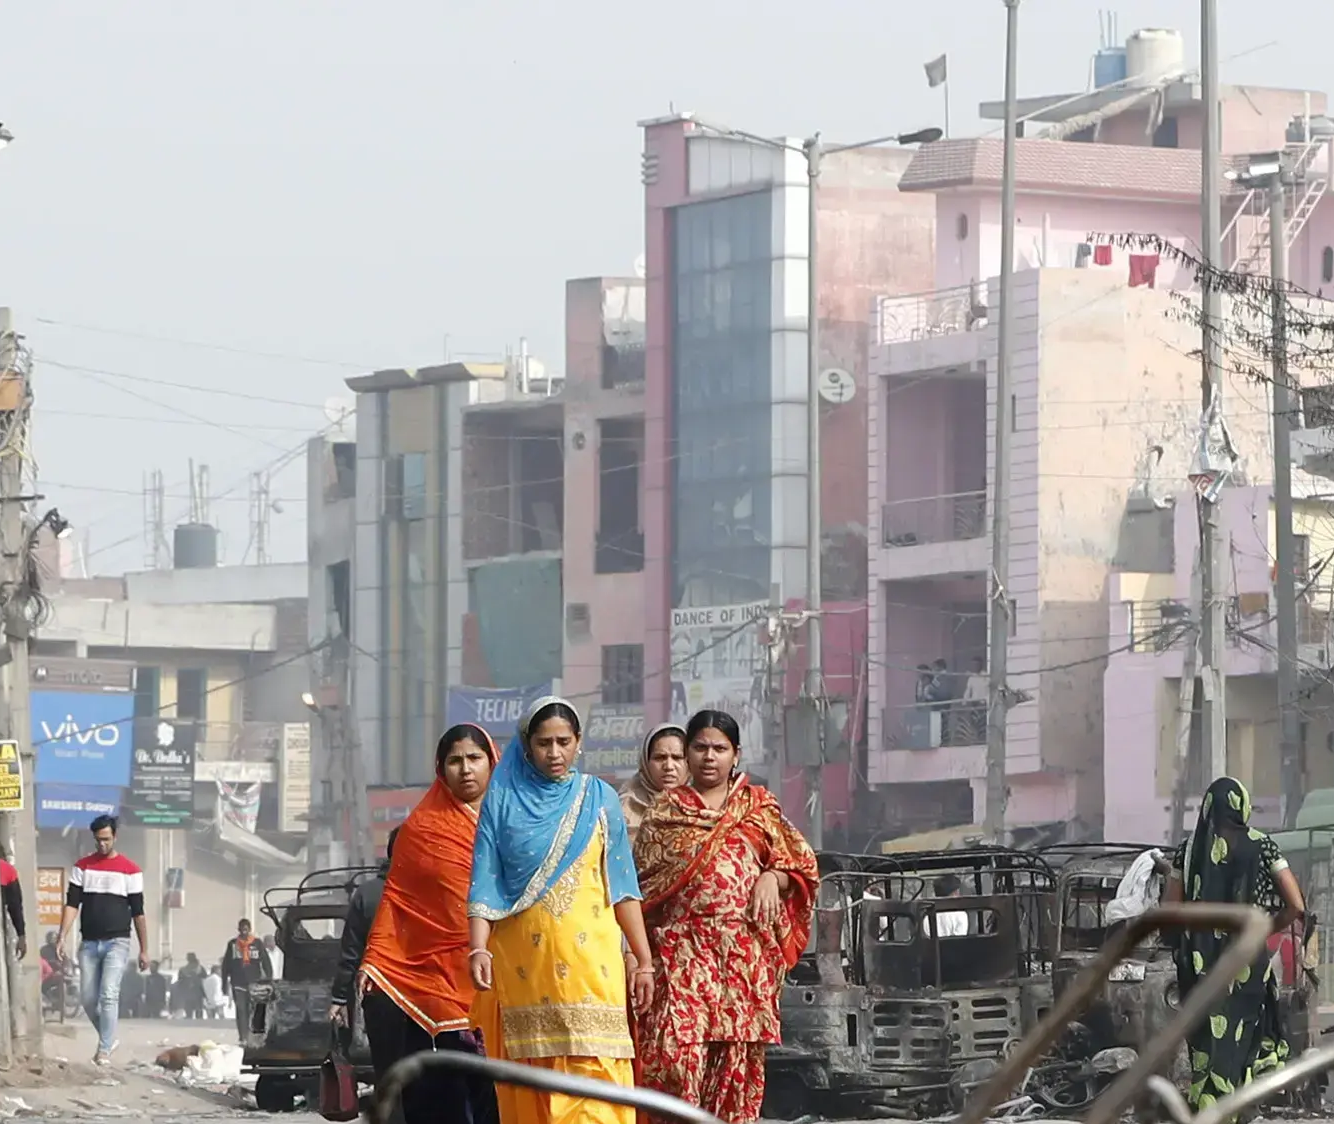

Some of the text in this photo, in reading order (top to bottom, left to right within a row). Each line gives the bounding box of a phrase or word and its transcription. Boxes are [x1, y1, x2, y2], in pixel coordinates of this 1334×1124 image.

[674, 611, 713, 626] DANCE
[720, 609, 735, 623] OF
[41, 714, 119, 746] vivo
[42, 799, 83, 811] SAMSUNG
